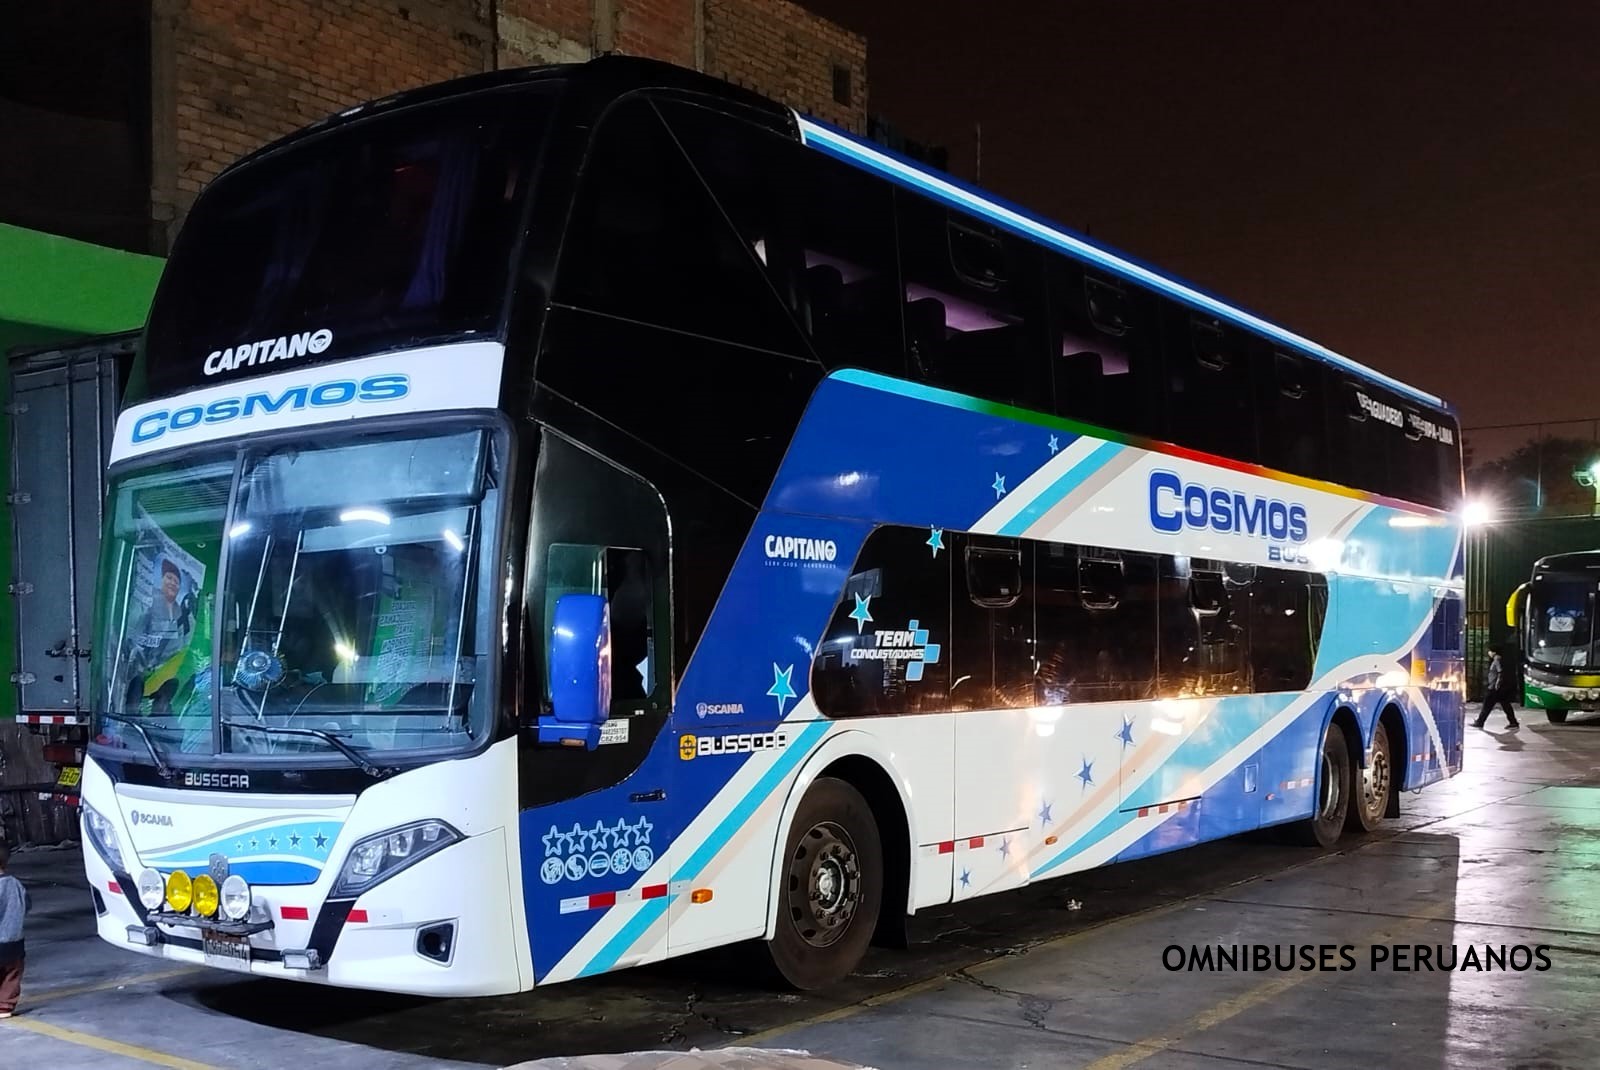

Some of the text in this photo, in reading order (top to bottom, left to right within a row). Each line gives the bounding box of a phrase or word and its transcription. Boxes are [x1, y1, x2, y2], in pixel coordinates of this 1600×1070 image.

[204, 329, 333, 376] CAPITANO
[131, 375, 410, 445] COSMOS
[1148, 469, 1308, 542] COSMOS
[765, 535, 837, 562] CAPITANO
[1268, 547, 1309, 565] BUS
[764, 560, 798, 568] SERVCIOS
[875, 630, 915, 647] TEAM
[850, 648, 924, 661] CONQUISTADORES
[708, 703, 744, 715] SCANIA
[697, 732, 787, 756] BUSSCAR
[184, 772, 250, 789] BUSSCAR
[140, 813, 174, 827] SCANIA
